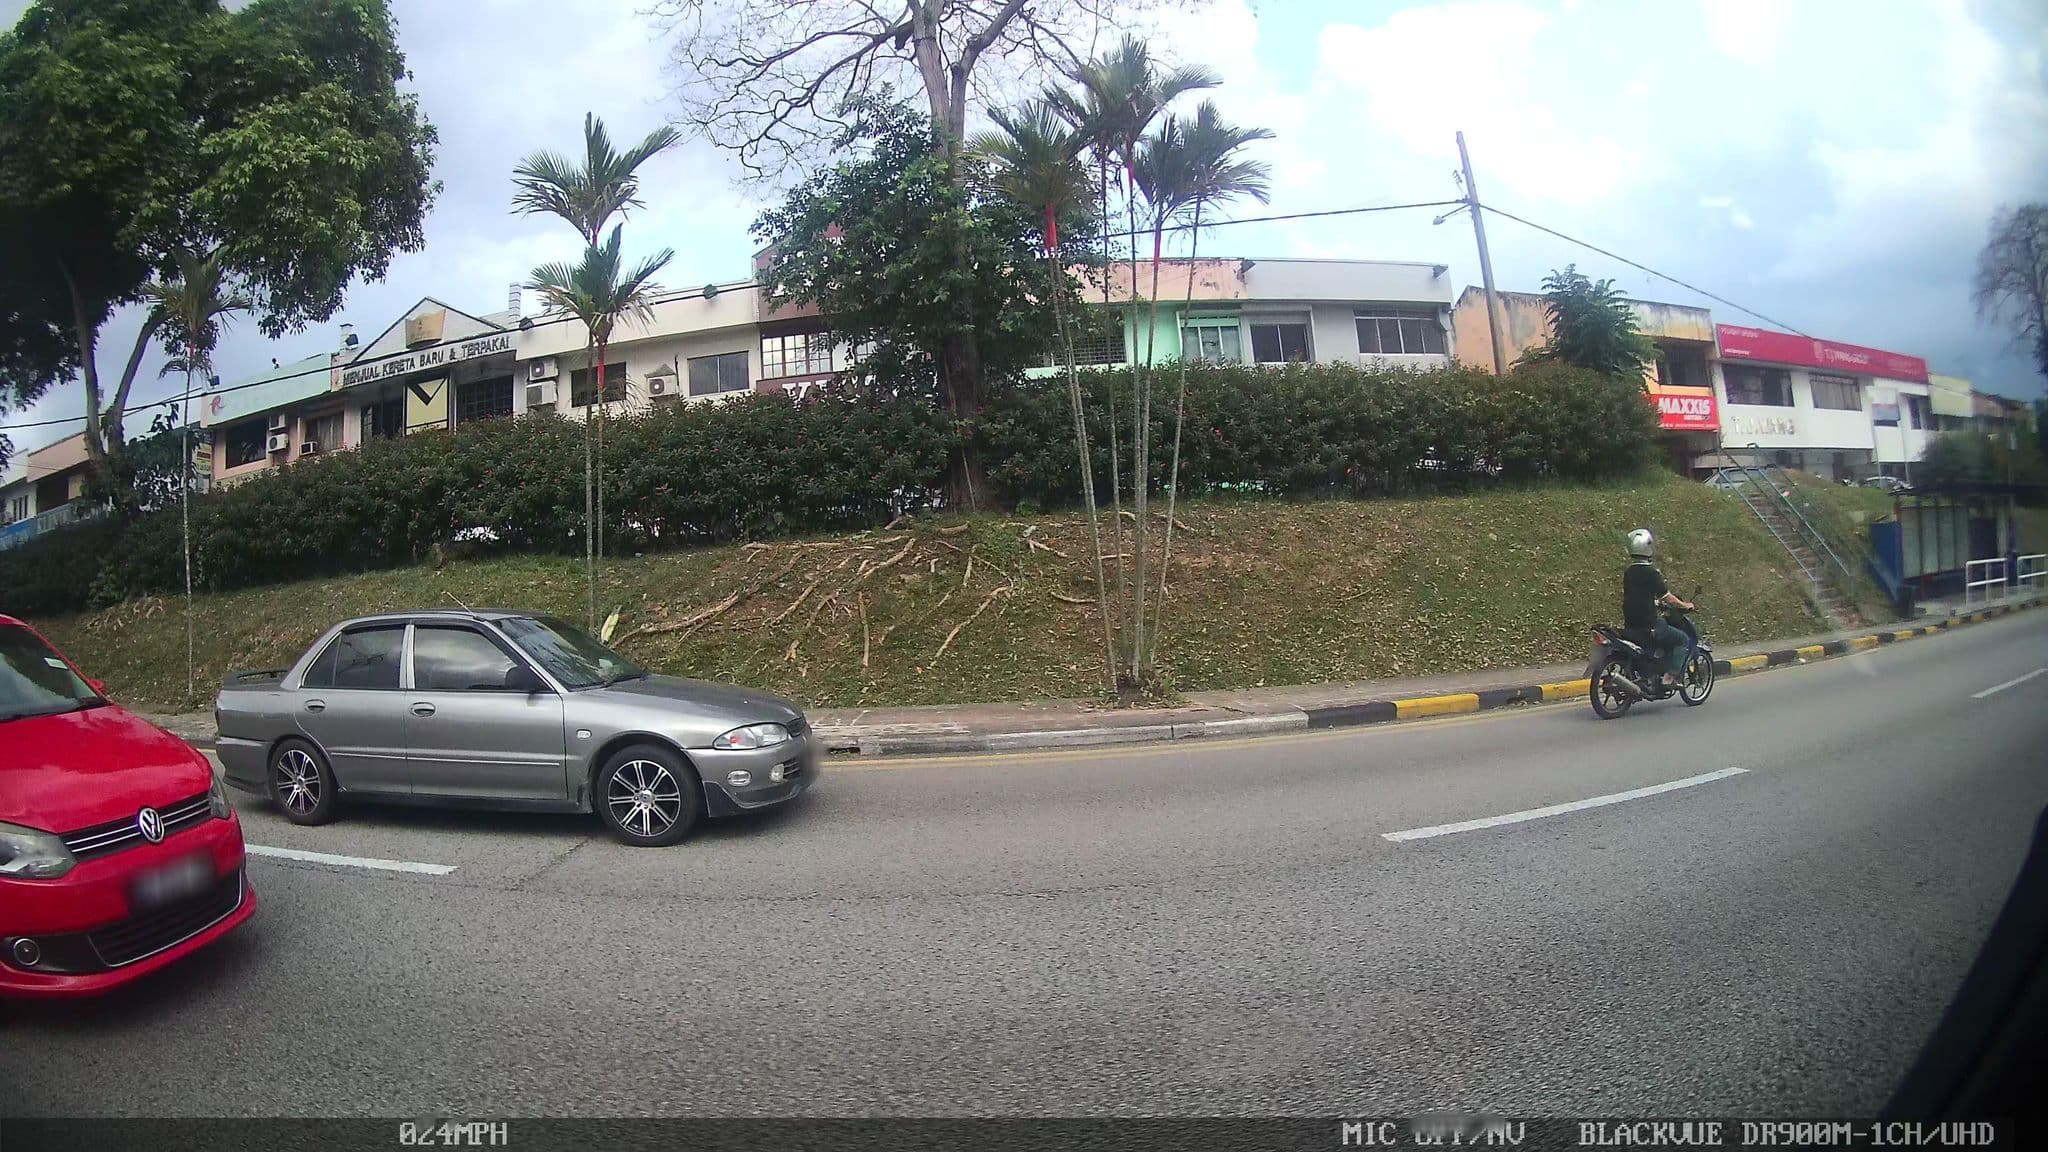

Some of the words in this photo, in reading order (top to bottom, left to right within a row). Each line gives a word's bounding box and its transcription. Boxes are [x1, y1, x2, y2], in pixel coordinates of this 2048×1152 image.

[343, 367, 380, 386] MENJUAL
[382, 358, 416, 377] KERETA
[419, 350, 444, 368] BARU
[449, 348, 457, 360] &
[461, 336, 510, 358] TERPAKAI
[1658, 397, 1711, 415] MAXXIS
